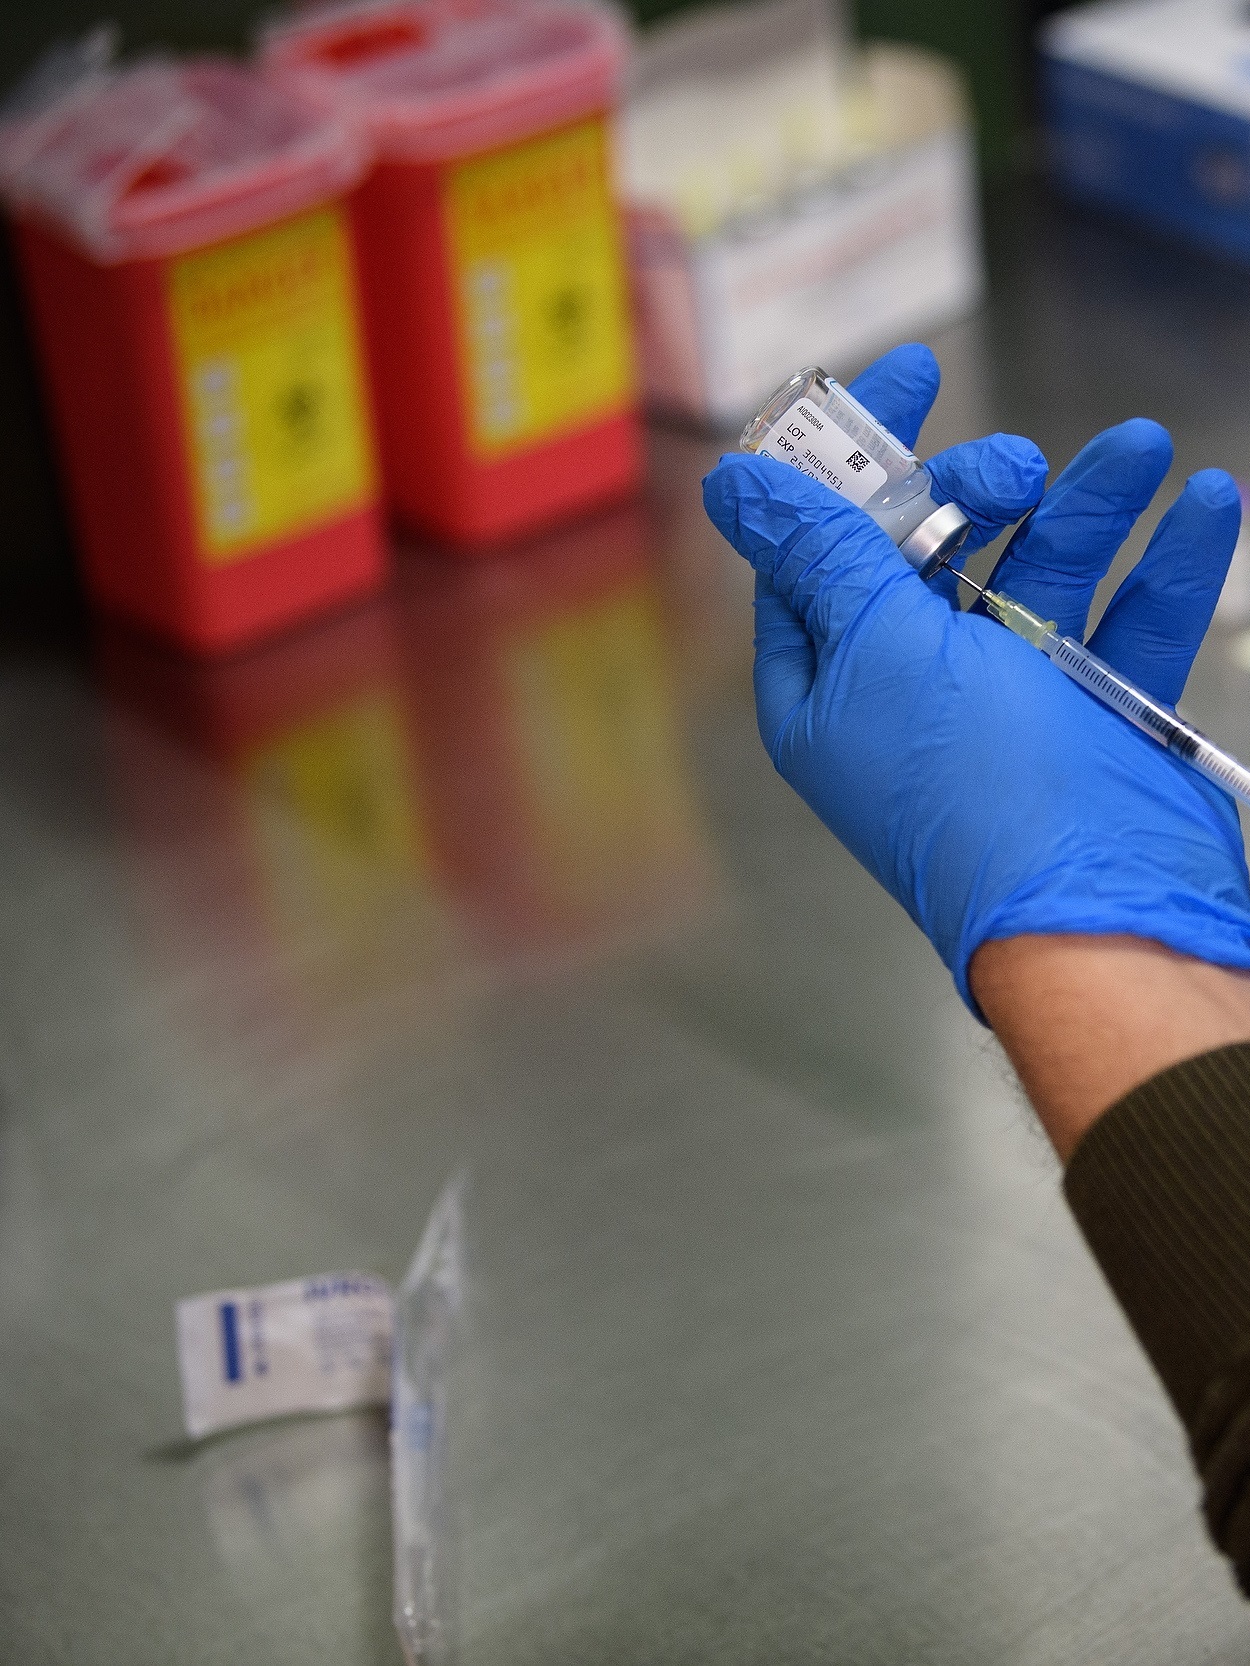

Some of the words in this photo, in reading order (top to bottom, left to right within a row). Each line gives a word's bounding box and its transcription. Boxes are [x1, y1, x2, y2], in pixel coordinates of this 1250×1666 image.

[776, 435, 795, 452] EXP
[786, 423, 806, 440] LOT
[802, 449, 843, 490] 3004951
